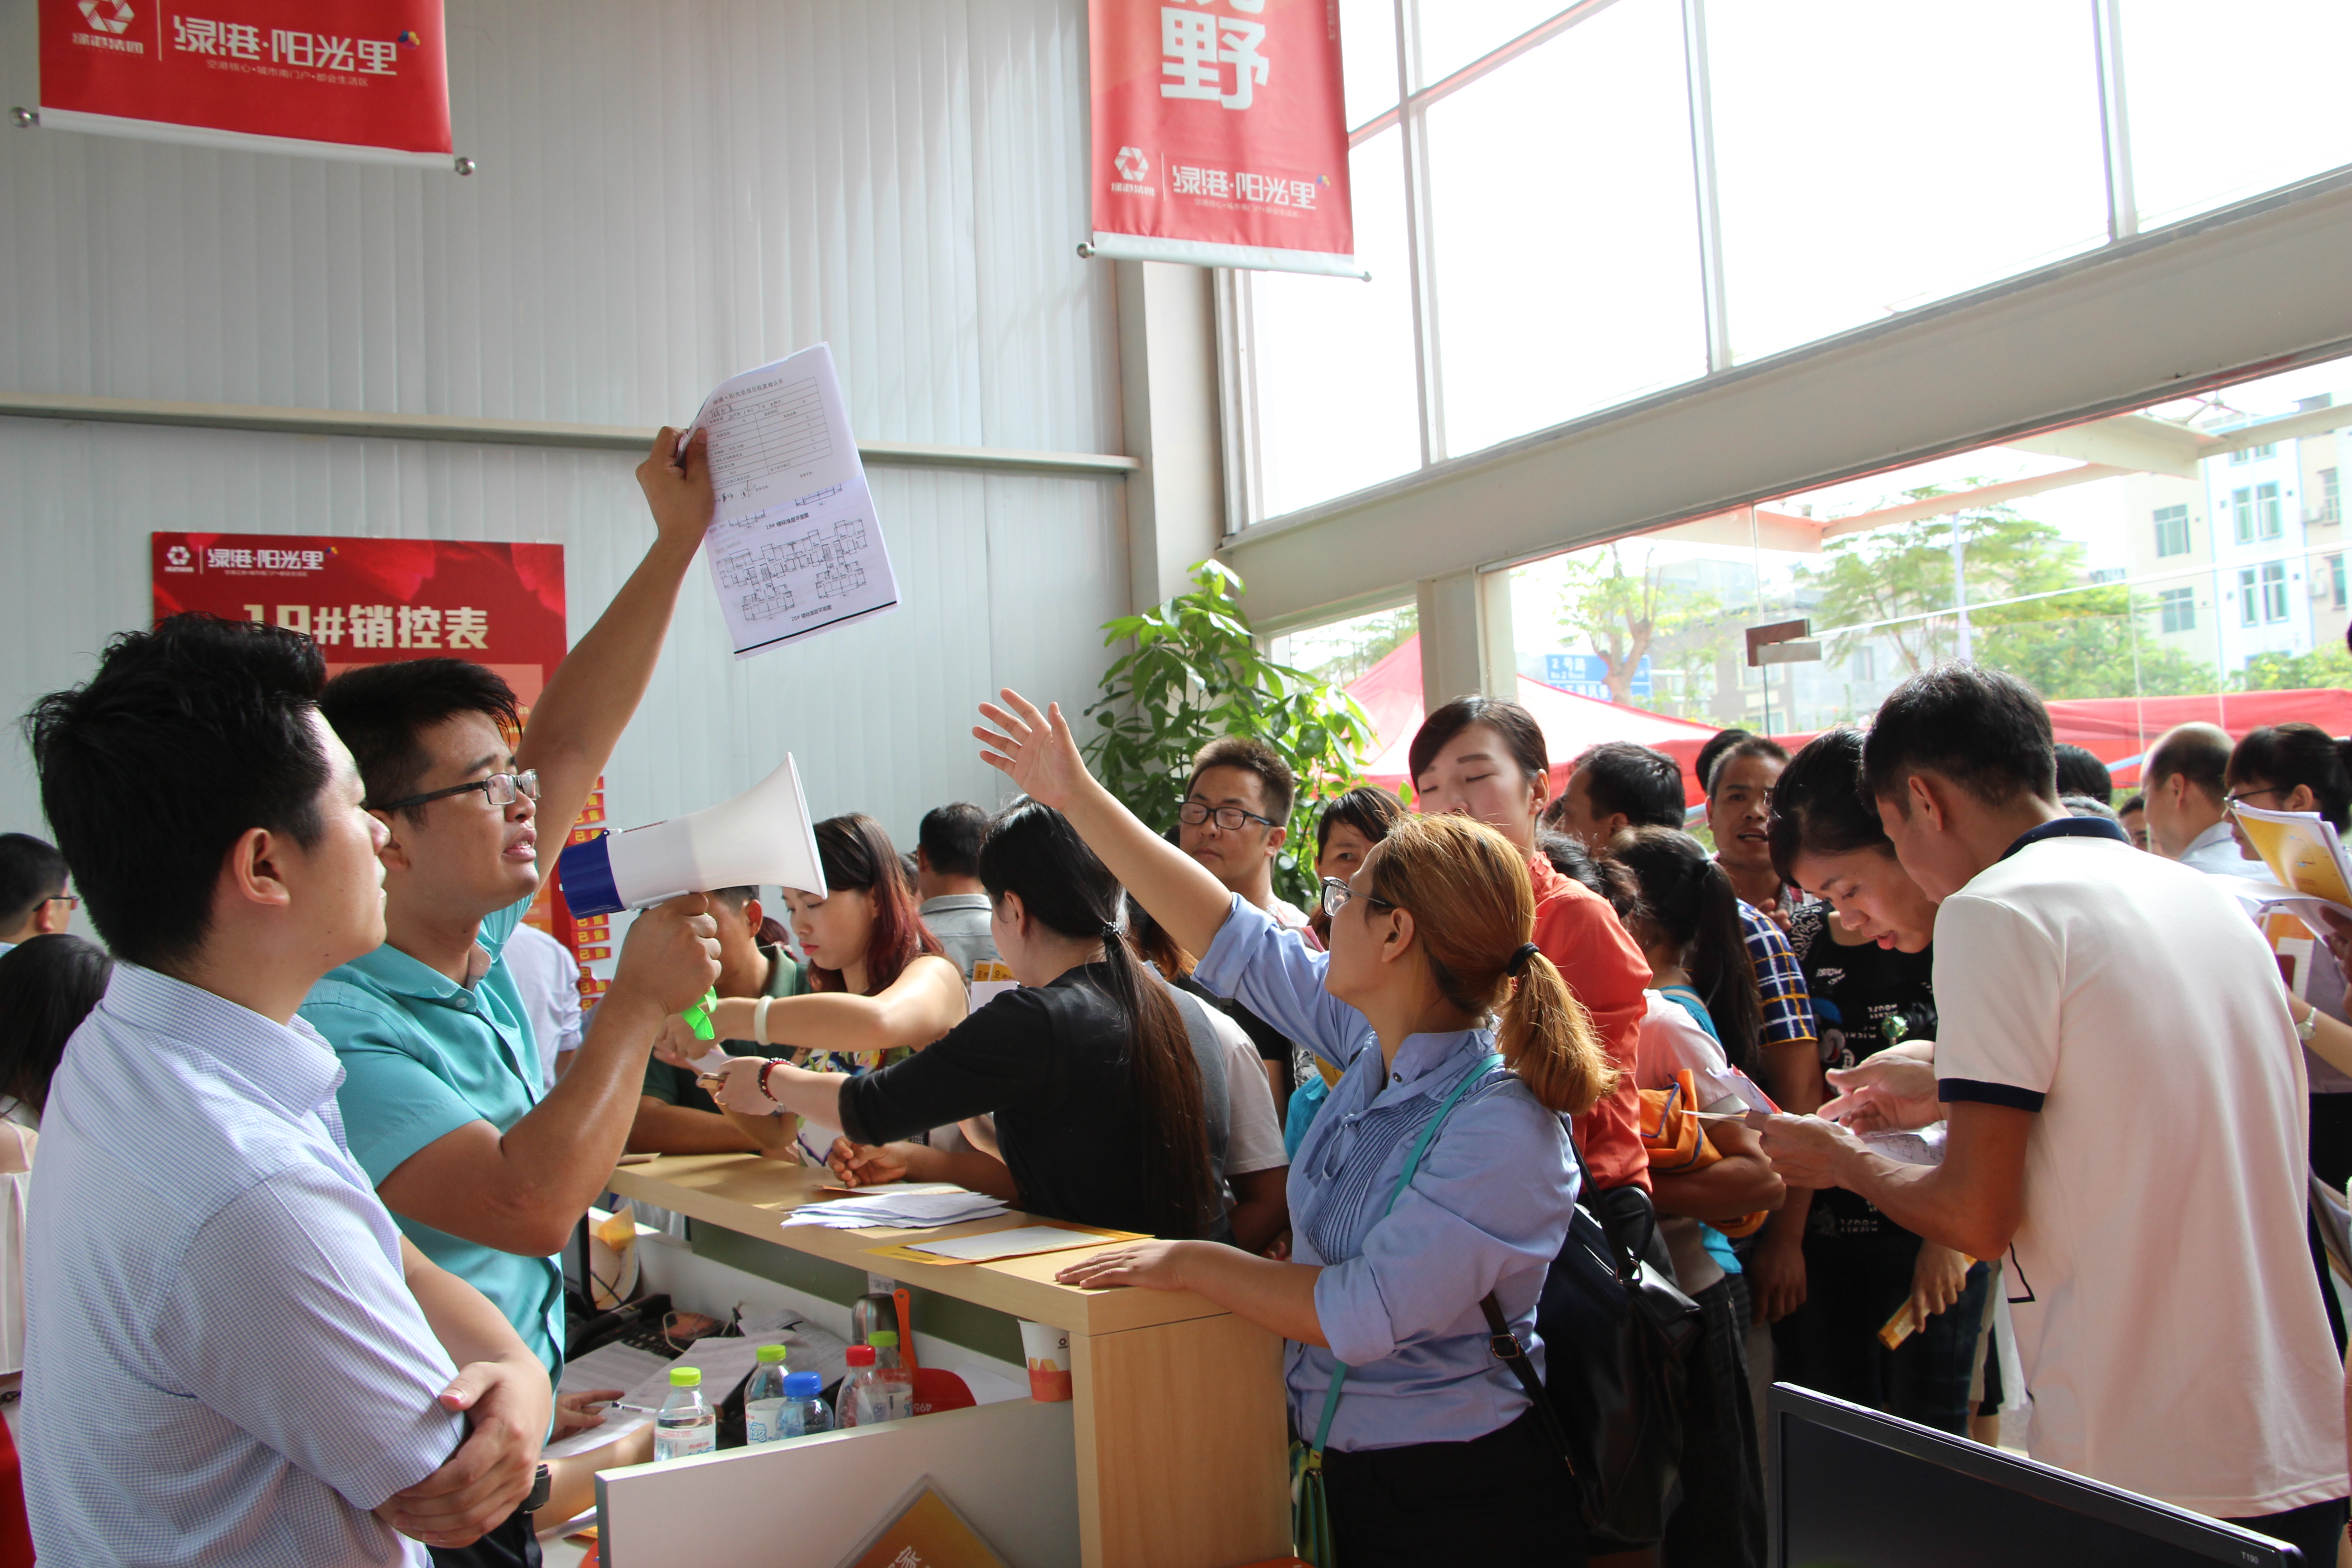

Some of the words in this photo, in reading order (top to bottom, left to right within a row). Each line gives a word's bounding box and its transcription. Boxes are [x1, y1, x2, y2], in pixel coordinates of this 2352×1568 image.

[173, 15, 397, 76] 绿港·阳光里
[1172, 165, 1316, 210] 绿港·阳光里
[207, 548, 324, 570] 绿港·阳光里
[2241, 1551, 2259, 1564] T190
